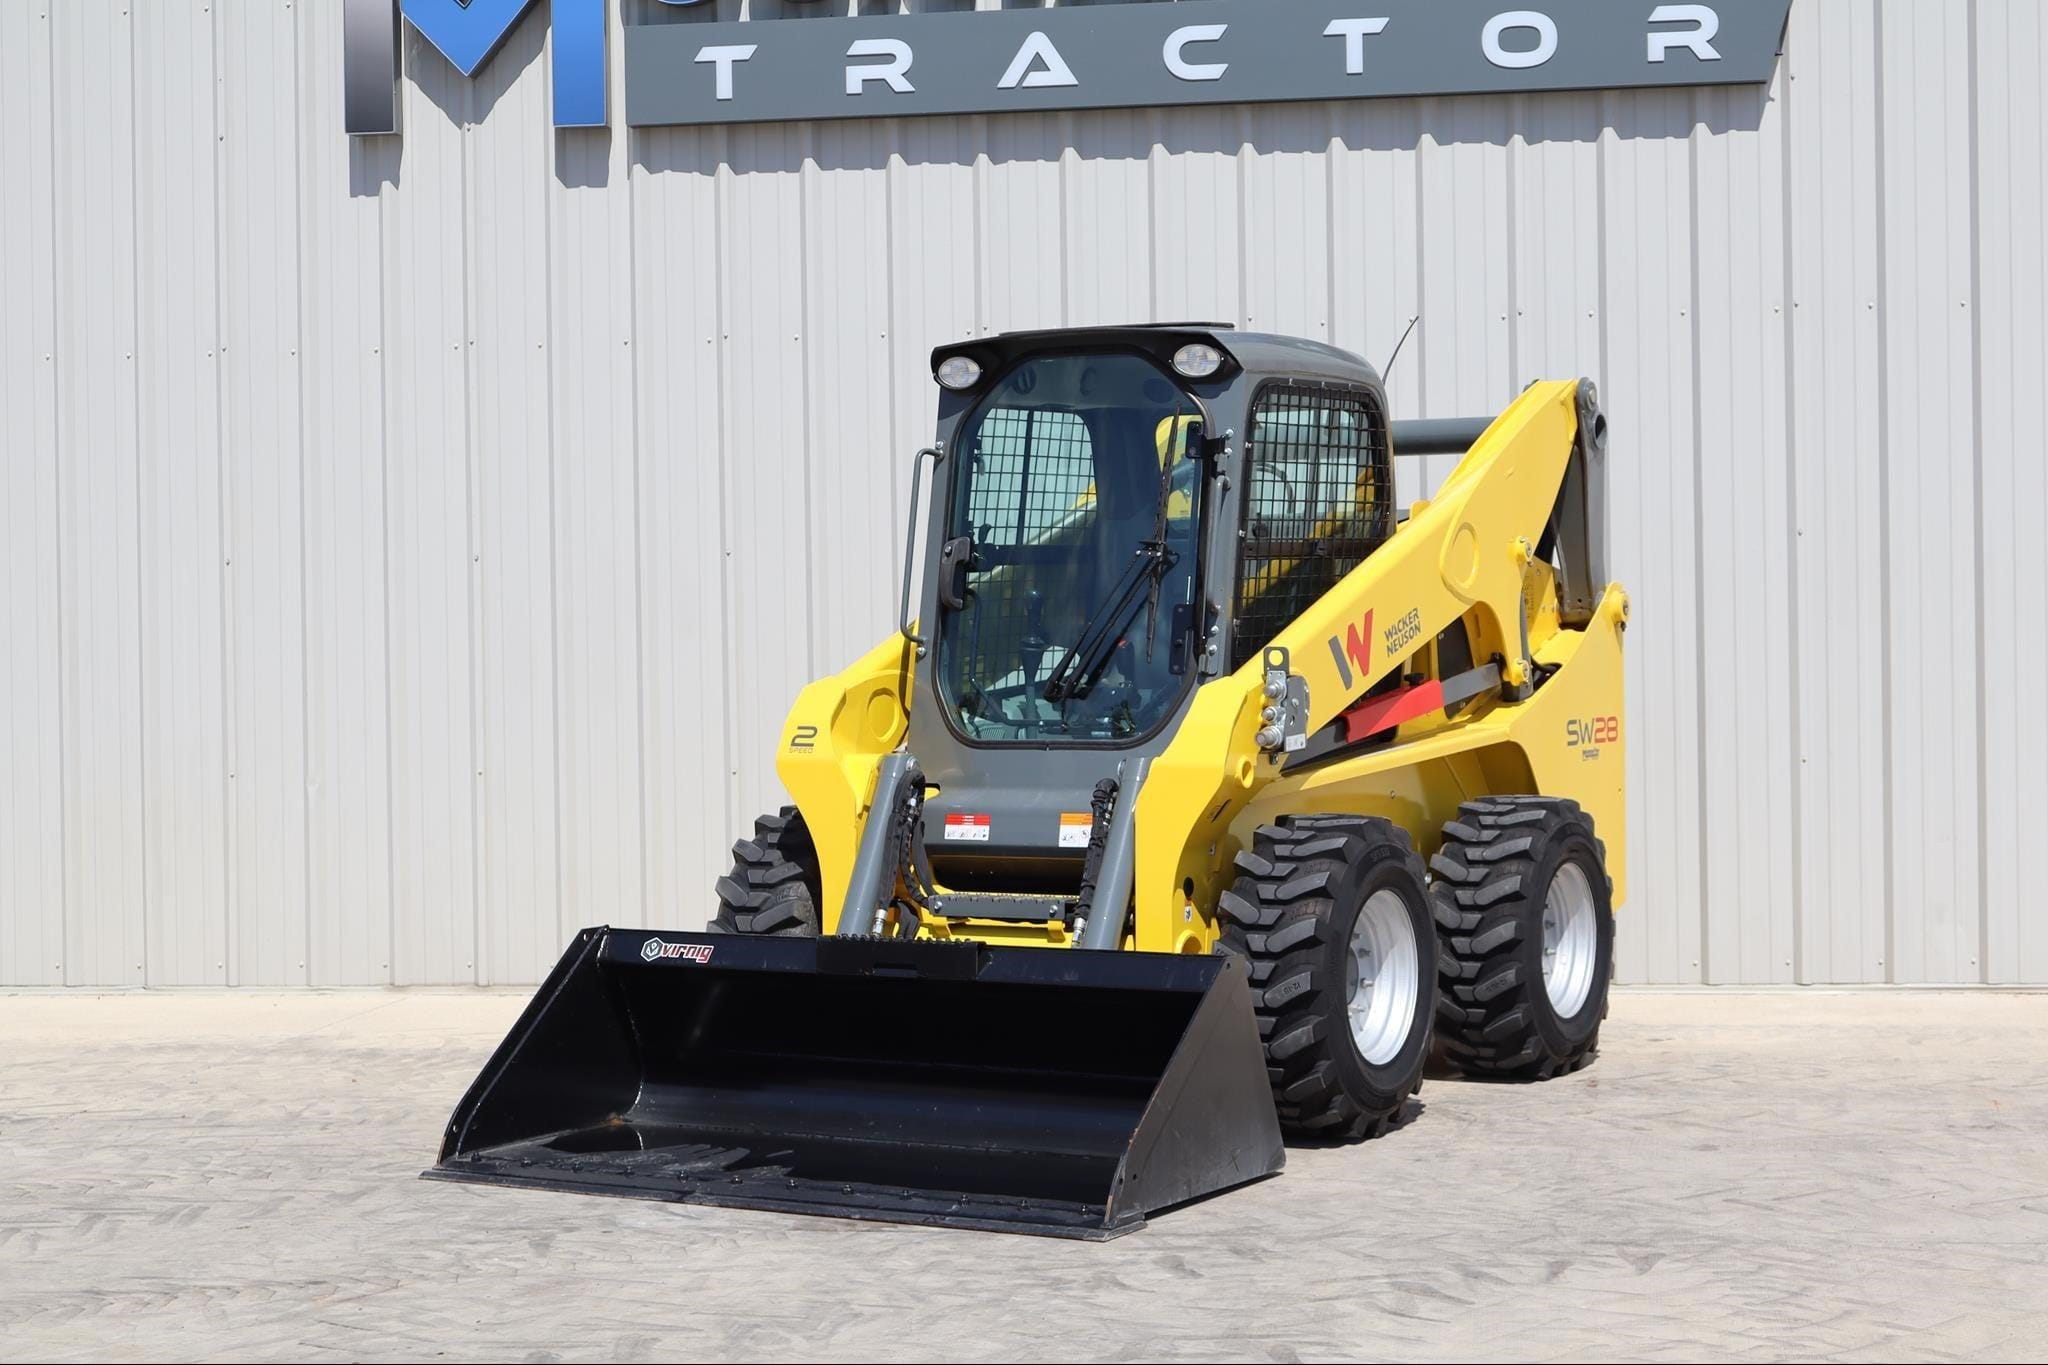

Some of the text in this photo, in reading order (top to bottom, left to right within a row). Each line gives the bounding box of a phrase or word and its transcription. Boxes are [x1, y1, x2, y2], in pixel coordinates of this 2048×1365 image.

[694, 4, 1722, 101] TRACTOR
[1384, 607, 1420, 643] WACKER
[1386, 620, 1422, 658] NEUSON
[790, 725, 818, 747] 2
[1566, 716, 1619, 747] SW28
